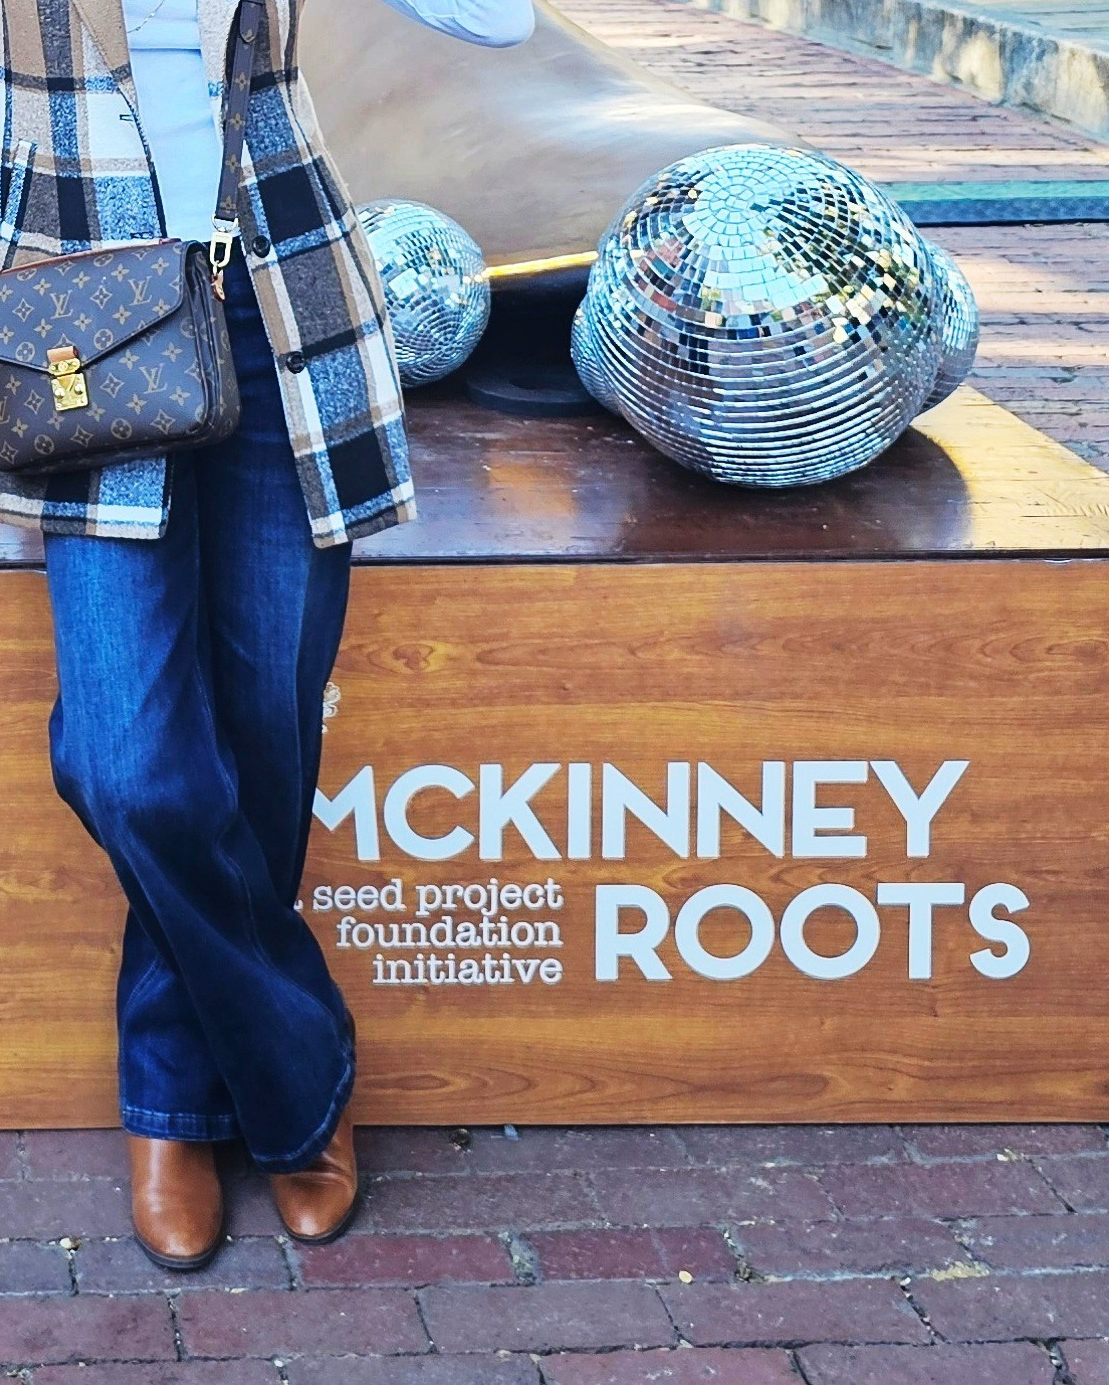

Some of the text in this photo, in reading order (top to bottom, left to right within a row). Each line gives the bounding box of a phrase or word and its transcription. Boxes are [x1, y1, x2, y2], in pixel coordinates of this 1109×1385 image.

[311, 760, 971, 862] MCKINNEY
[312, 877, 564, 917] seed project
[335, 915, 564, 949] foundation
[594, 882, 1032, 982] ROOTS
[372, 952, 563, 984] initiative
